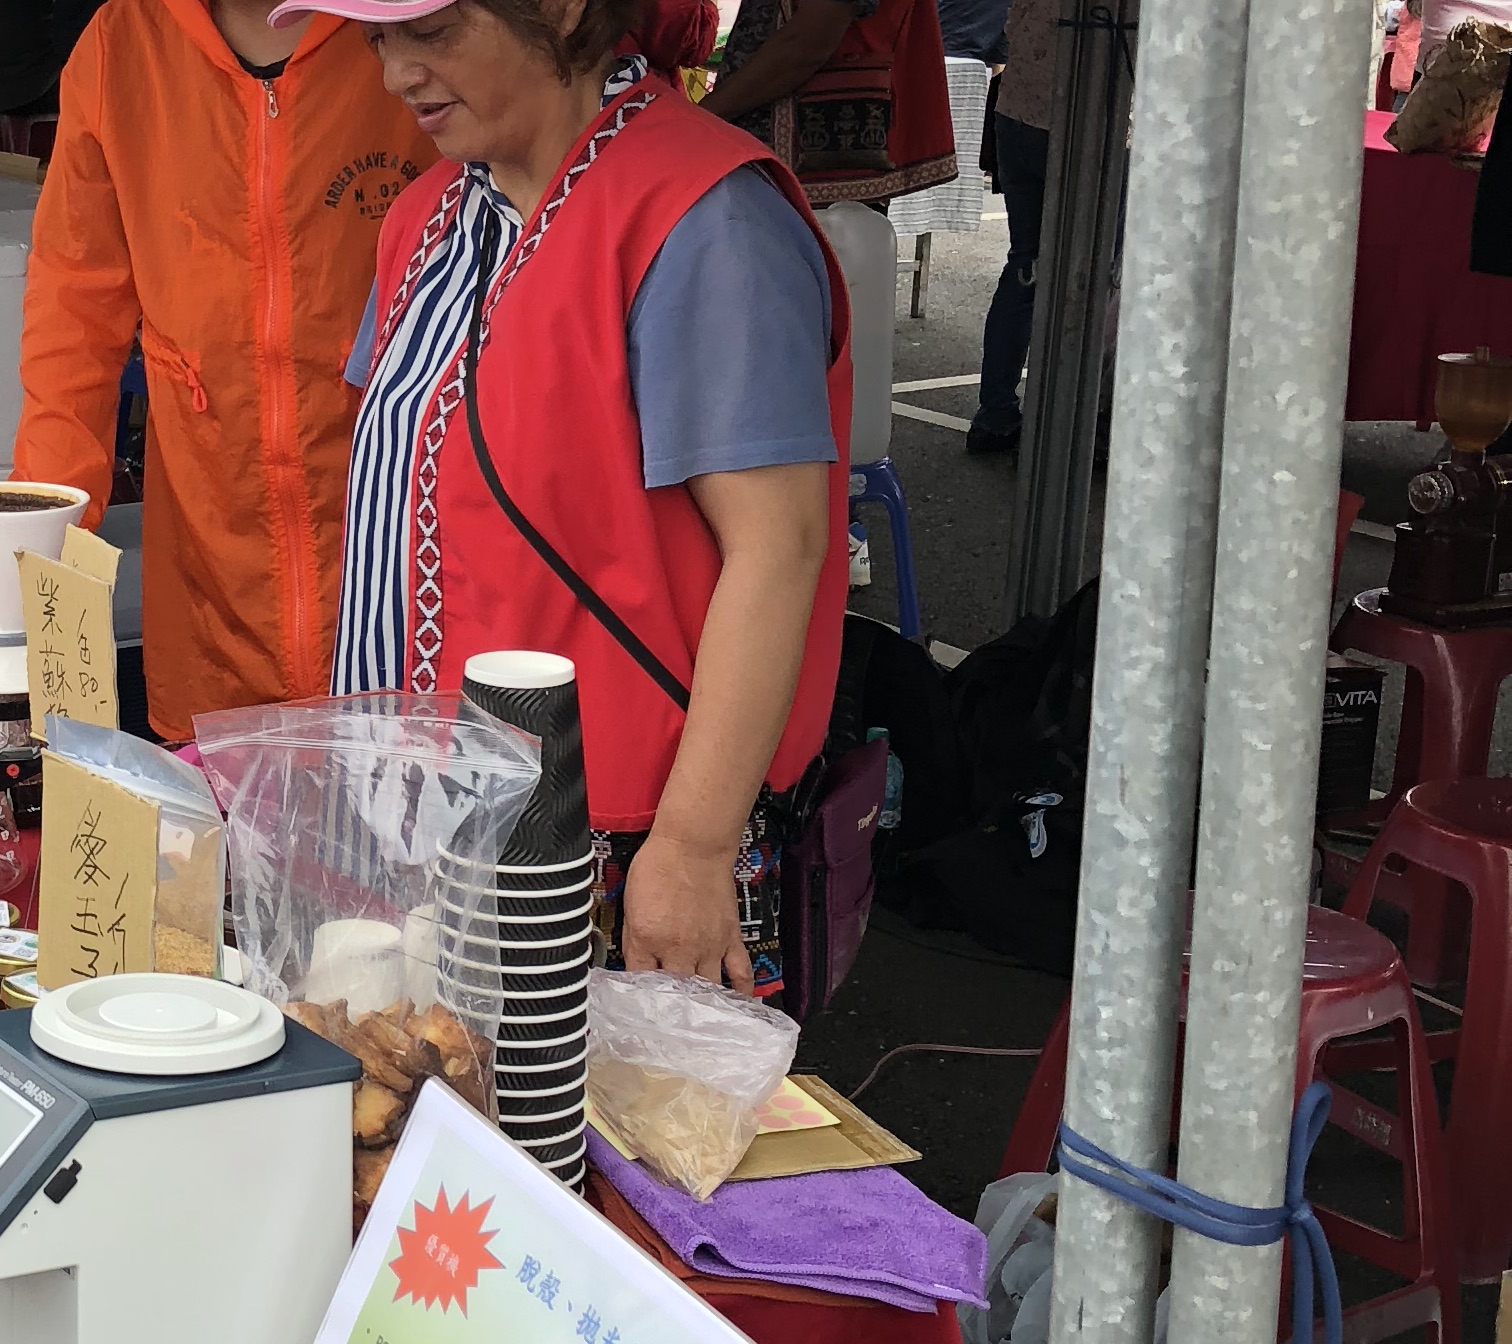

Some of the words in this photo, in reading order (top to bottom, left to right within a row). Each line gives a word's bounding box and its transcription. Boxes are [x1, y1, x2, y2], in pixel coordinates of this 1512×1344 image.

[353, 151, 387, 173] HAVE
[390, 155, 399, 170] A
[19, 1078, 56, 1109] PM-650
